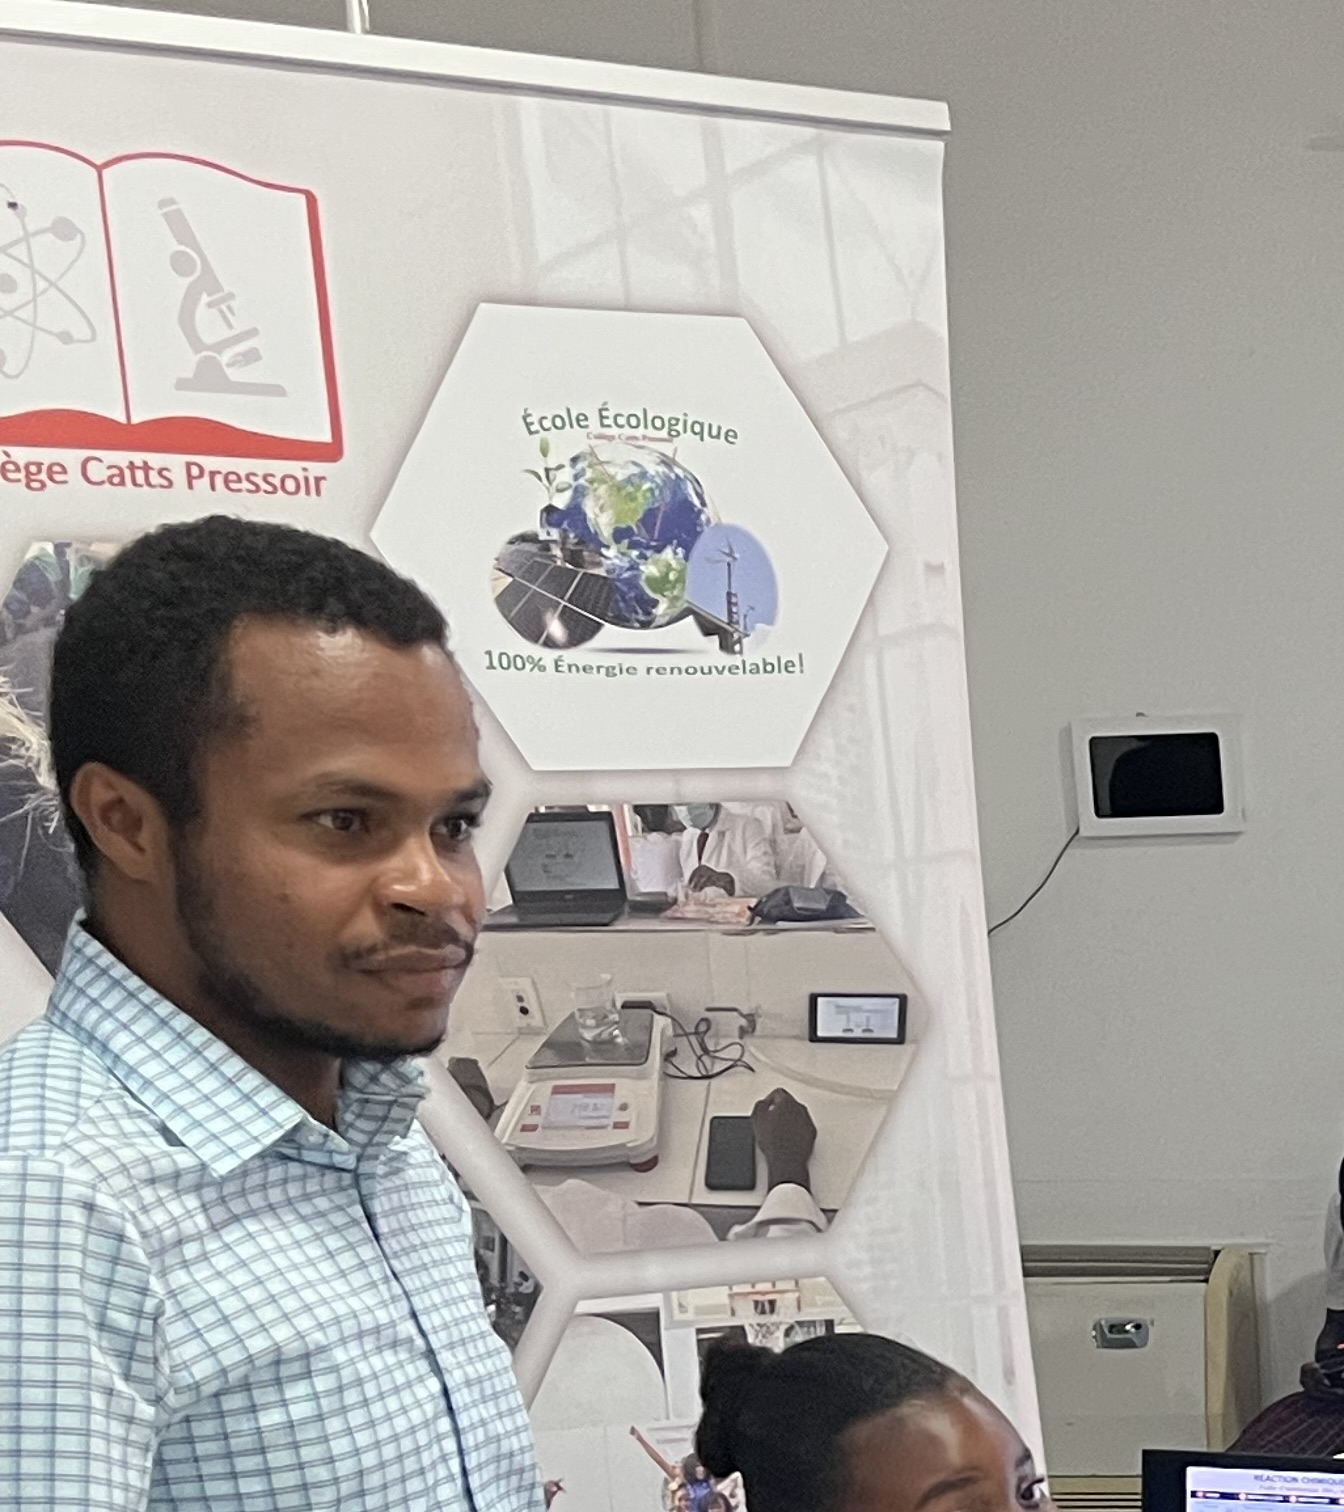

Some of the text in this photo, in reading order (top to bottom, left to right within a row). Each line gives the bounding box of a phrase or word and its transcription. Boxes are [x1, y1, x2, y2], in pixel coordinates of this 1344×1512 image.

[522, 402, 739, 445] École Écologique
[81, 456, 173, 489] Catts
[186, 461, 327, 497] Pressoir
[484, 649, 805, 677] 100% Énergie renouvelable!
